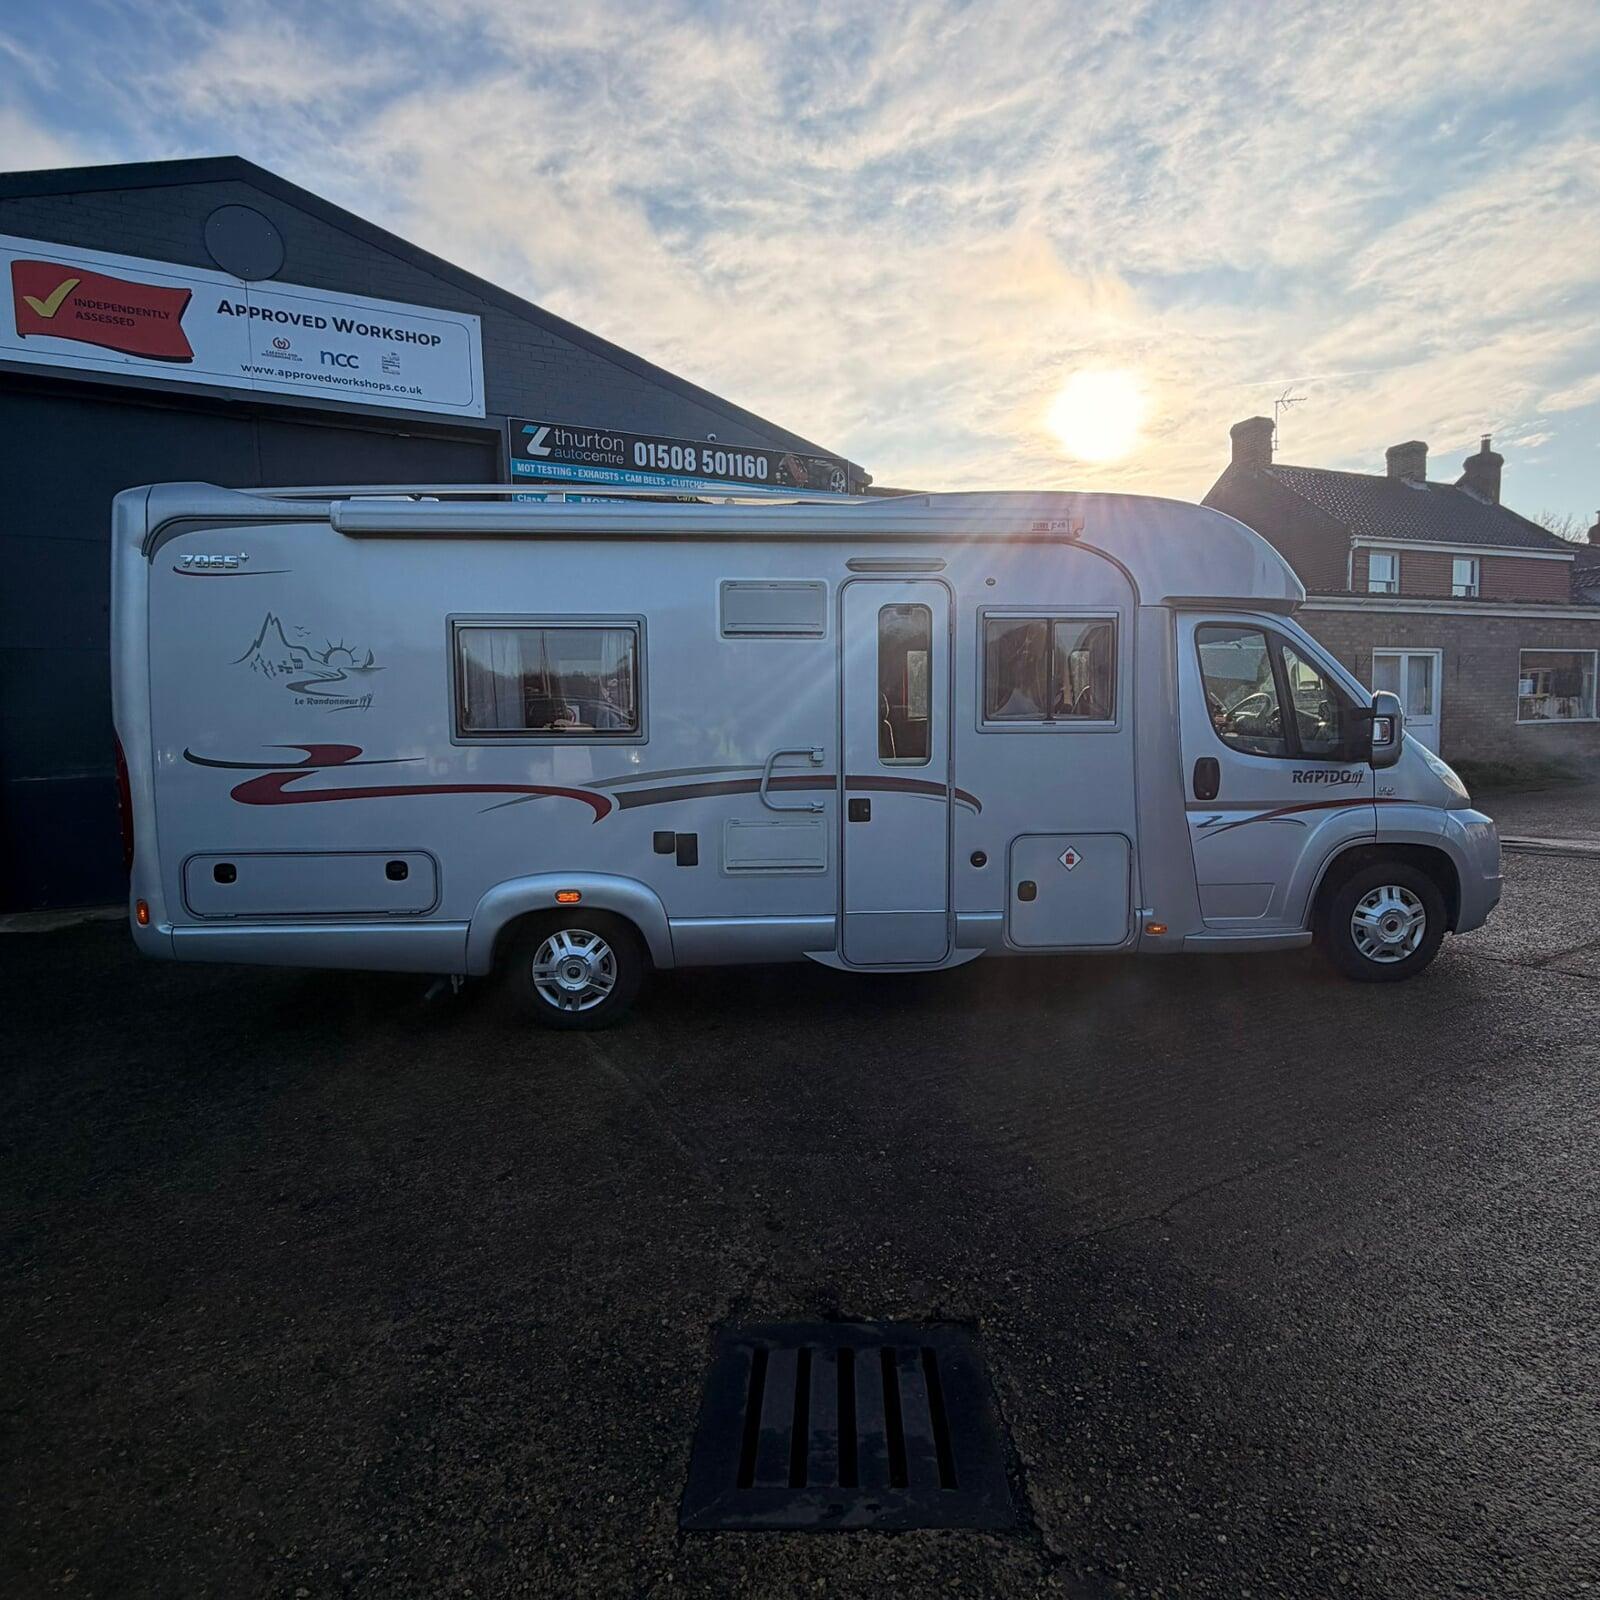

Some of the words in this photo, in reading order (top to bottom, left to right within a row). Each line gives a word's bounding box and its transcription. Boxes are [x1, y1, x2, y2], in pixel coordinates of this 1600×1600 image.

[74, 298, 170, 320] INDEPENDENTLY
[75, 311, 135, 327] ASSESSED
[217, 299, 327, 330] APPROVED
[331, 316, 441, 347] WORKSHOP
[320, 350, 360, 369] ncc
[240, 363, 423, 395] www.approvedworkshops.co.uk
[554, 428, 625, 452] thurton
[554, 447, 625, 465] autocentre
[634, 441, 697, 472] 01508
[702, 450, 768, 480] 501160
[517, 463, 535, 472] MOT
[537, 465, 572, 476] TESTING
[578, 469, 619, 481] EXHAUSTS
[625, 474, 643, 484] CAM
[644, 476, 666, 487] BELTS
[294, 697, 305, 705] Le
[306, 697, 359, 706] Randonneur
